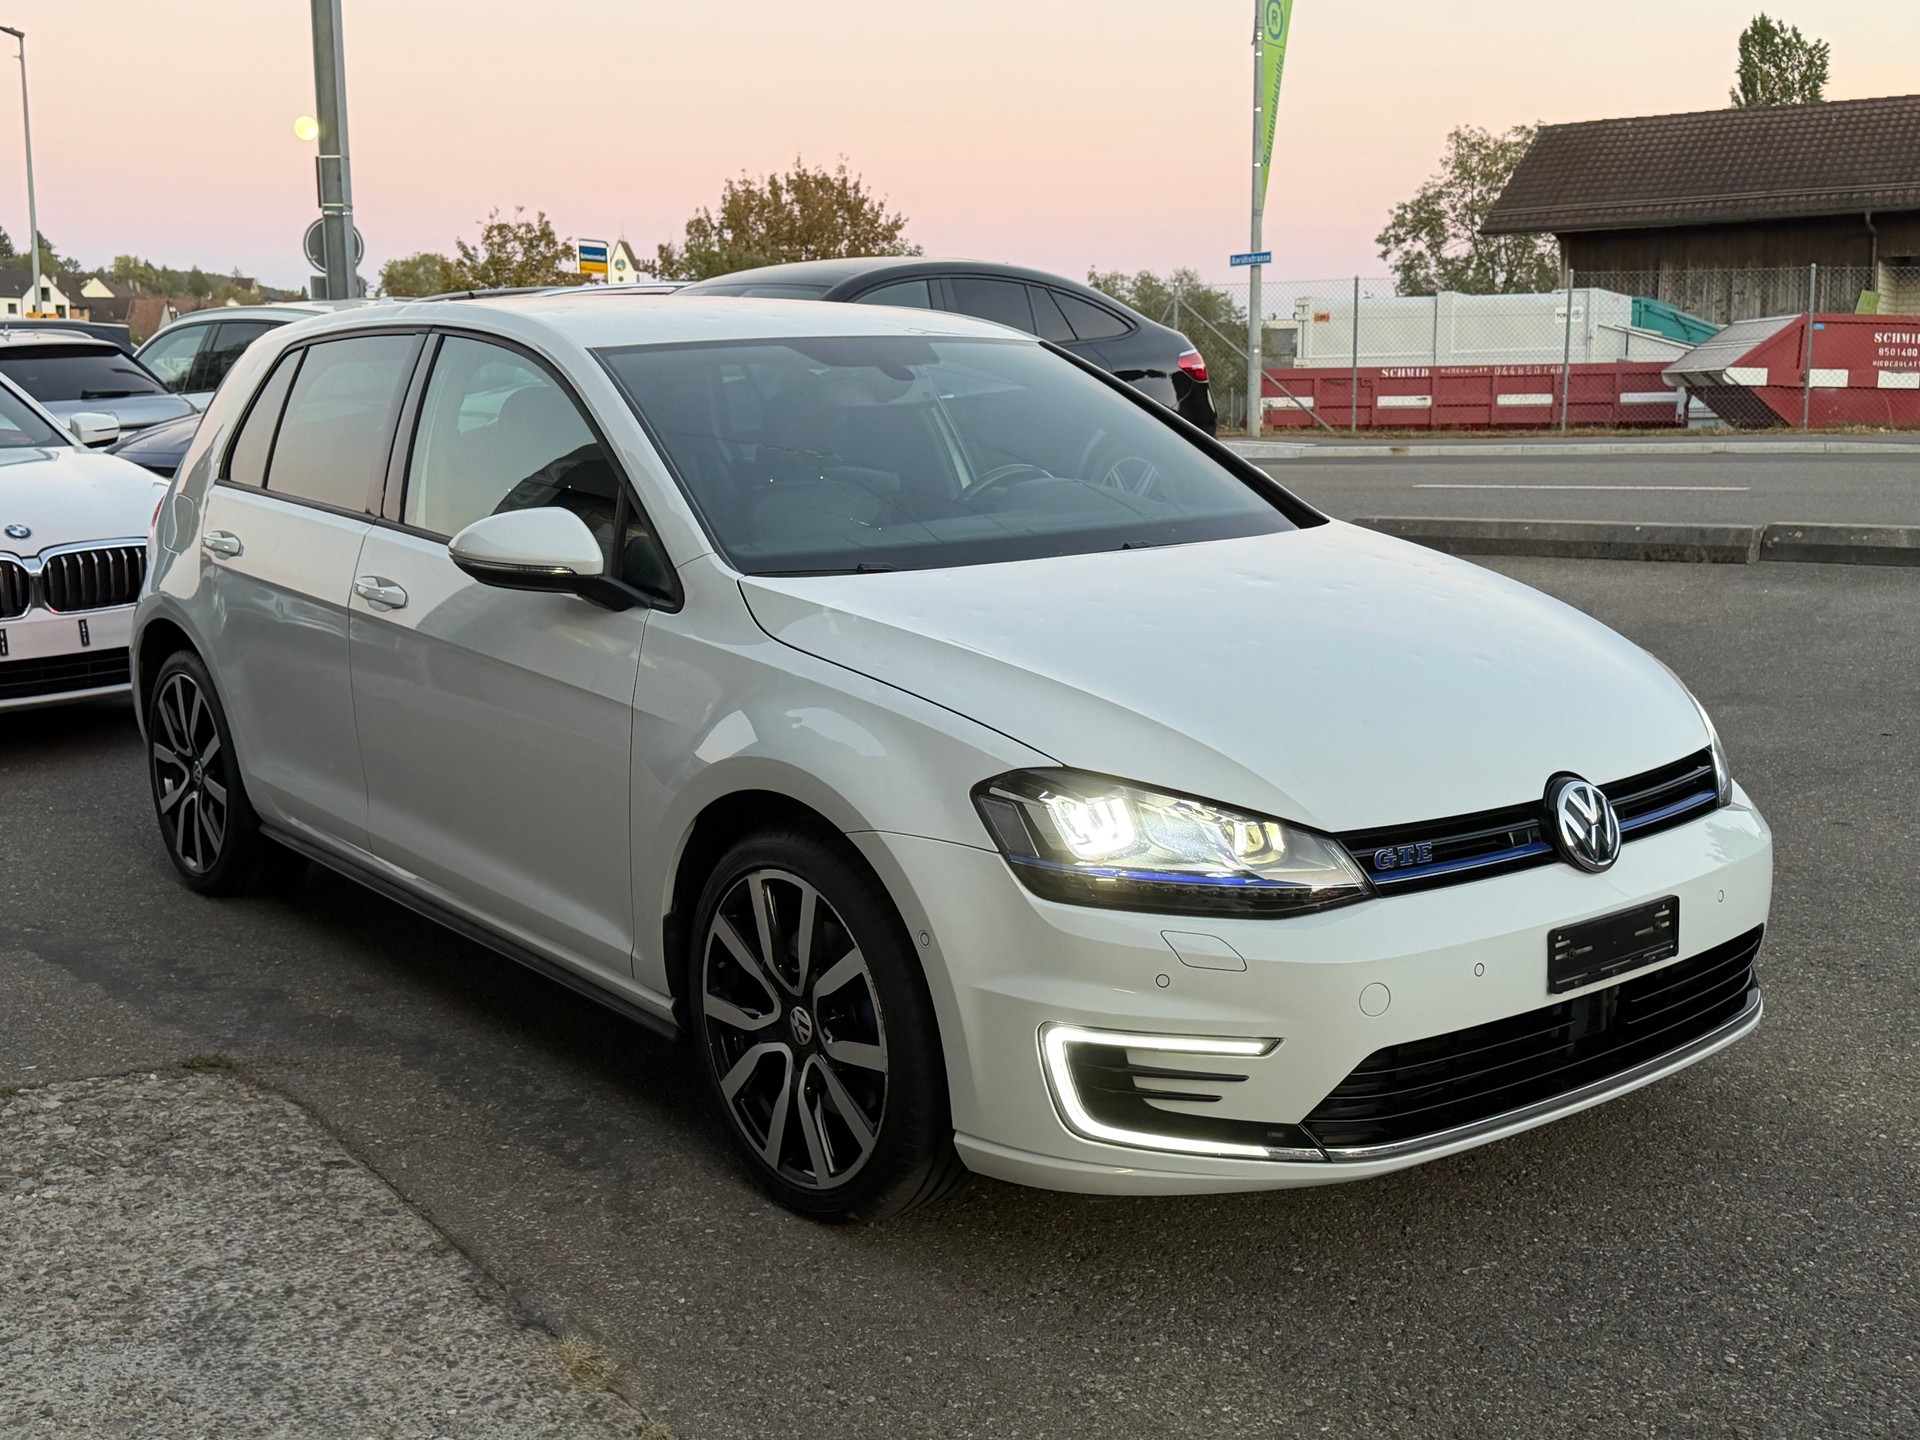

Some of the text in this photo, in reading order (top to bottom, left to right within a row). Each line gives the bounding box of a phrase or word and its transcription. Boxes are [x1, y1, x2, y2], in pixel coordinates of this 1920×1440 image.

[1872, 360, 1920, 368] NIEDERGLAT
[1381, 367, 1430, 378] SCHMID
[1374, 841, 1433, 870] GTE
